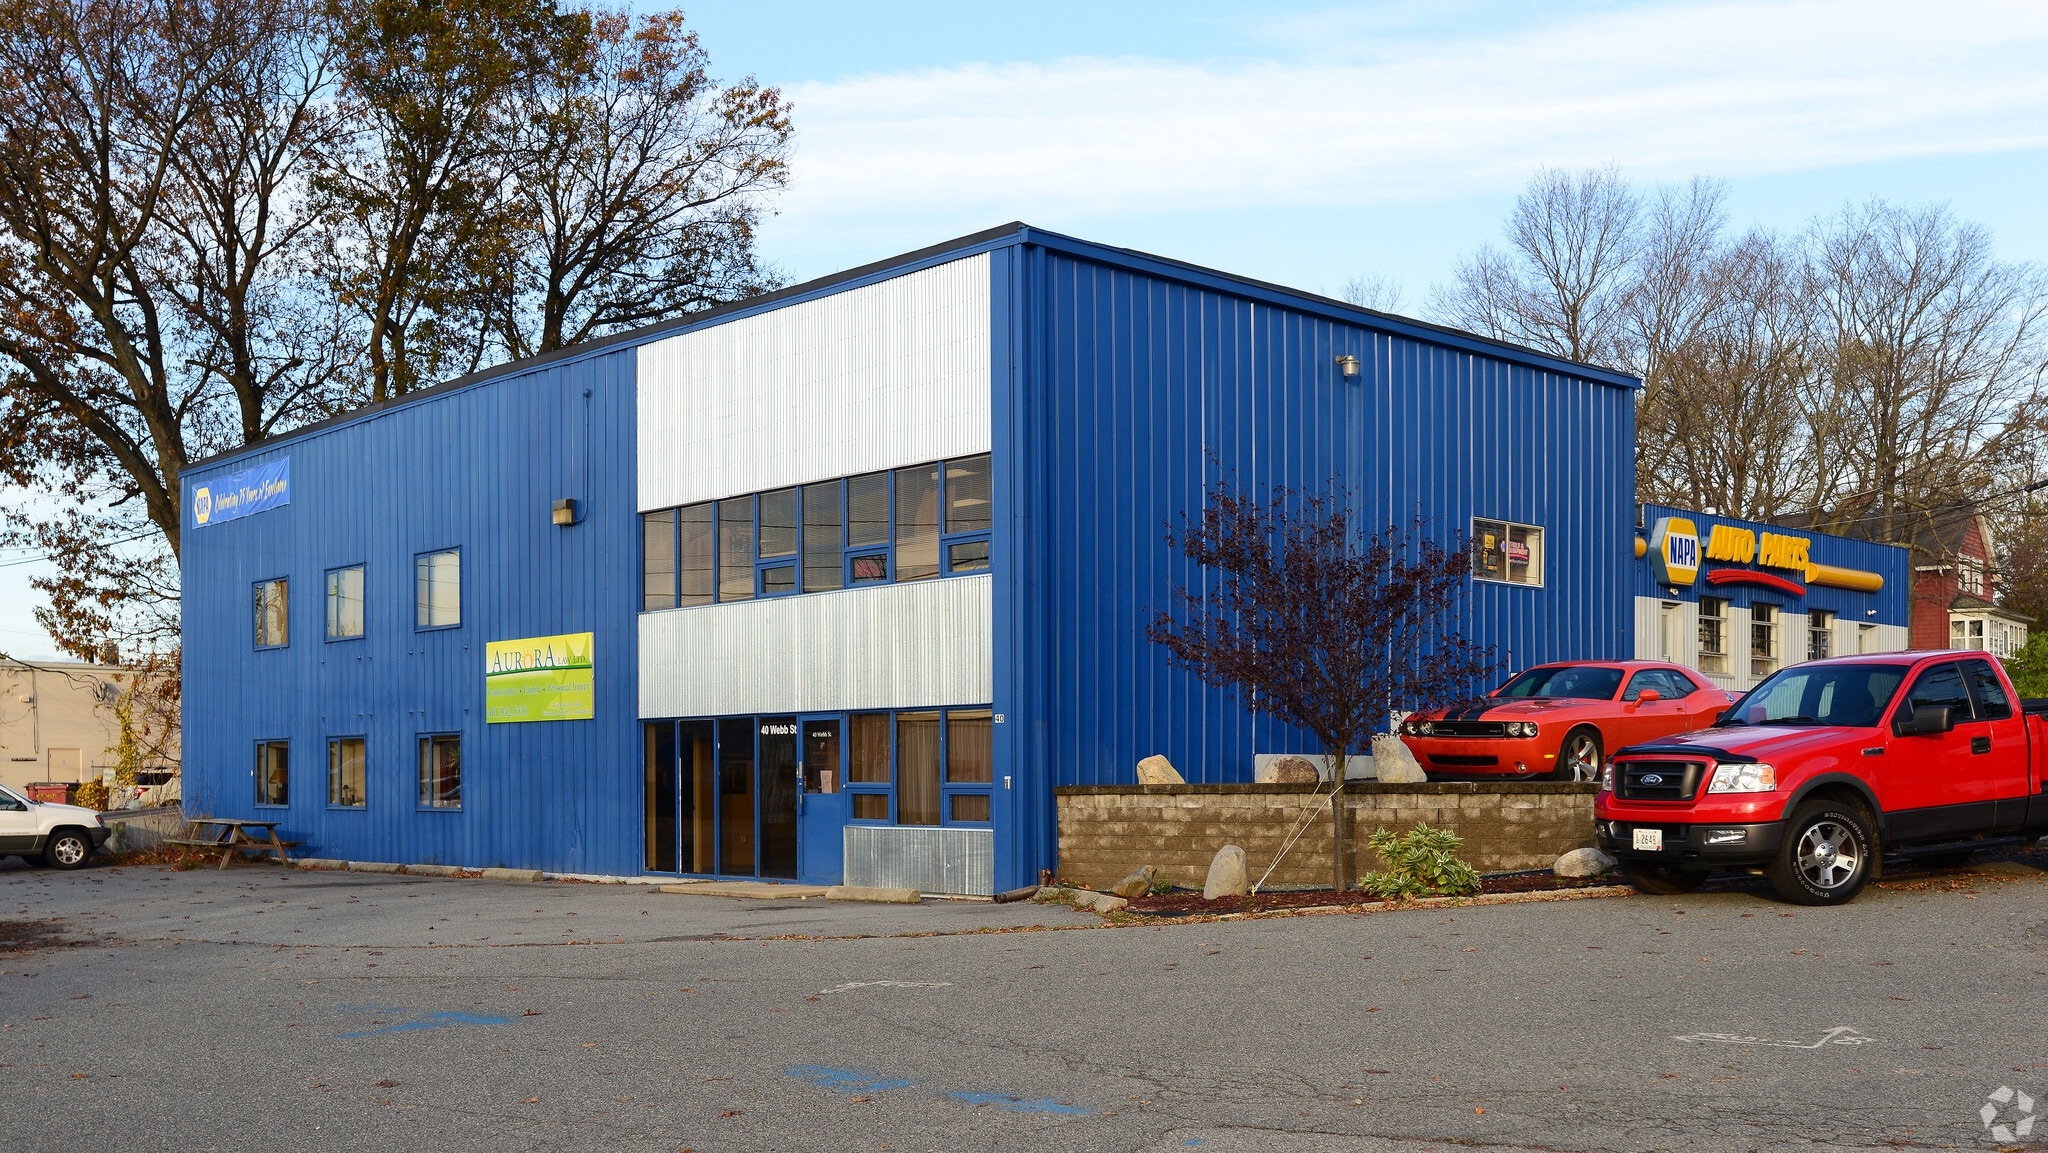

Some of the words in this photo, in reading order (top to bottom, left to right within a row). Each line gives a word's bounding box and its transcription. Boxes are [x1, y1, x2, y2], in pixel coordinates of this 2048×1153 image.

[1670, 536, 1696, 567] NAPA
[1706, 524, 1756, 564] AUTO
[1758, 531, 1811, 571] PARTS
[492, 643, 556, 673] AURORA
[761, 725, 769, 735] 40
[770, 724, 789, 735] Webb
[995, 714, 1004, 722] 40
